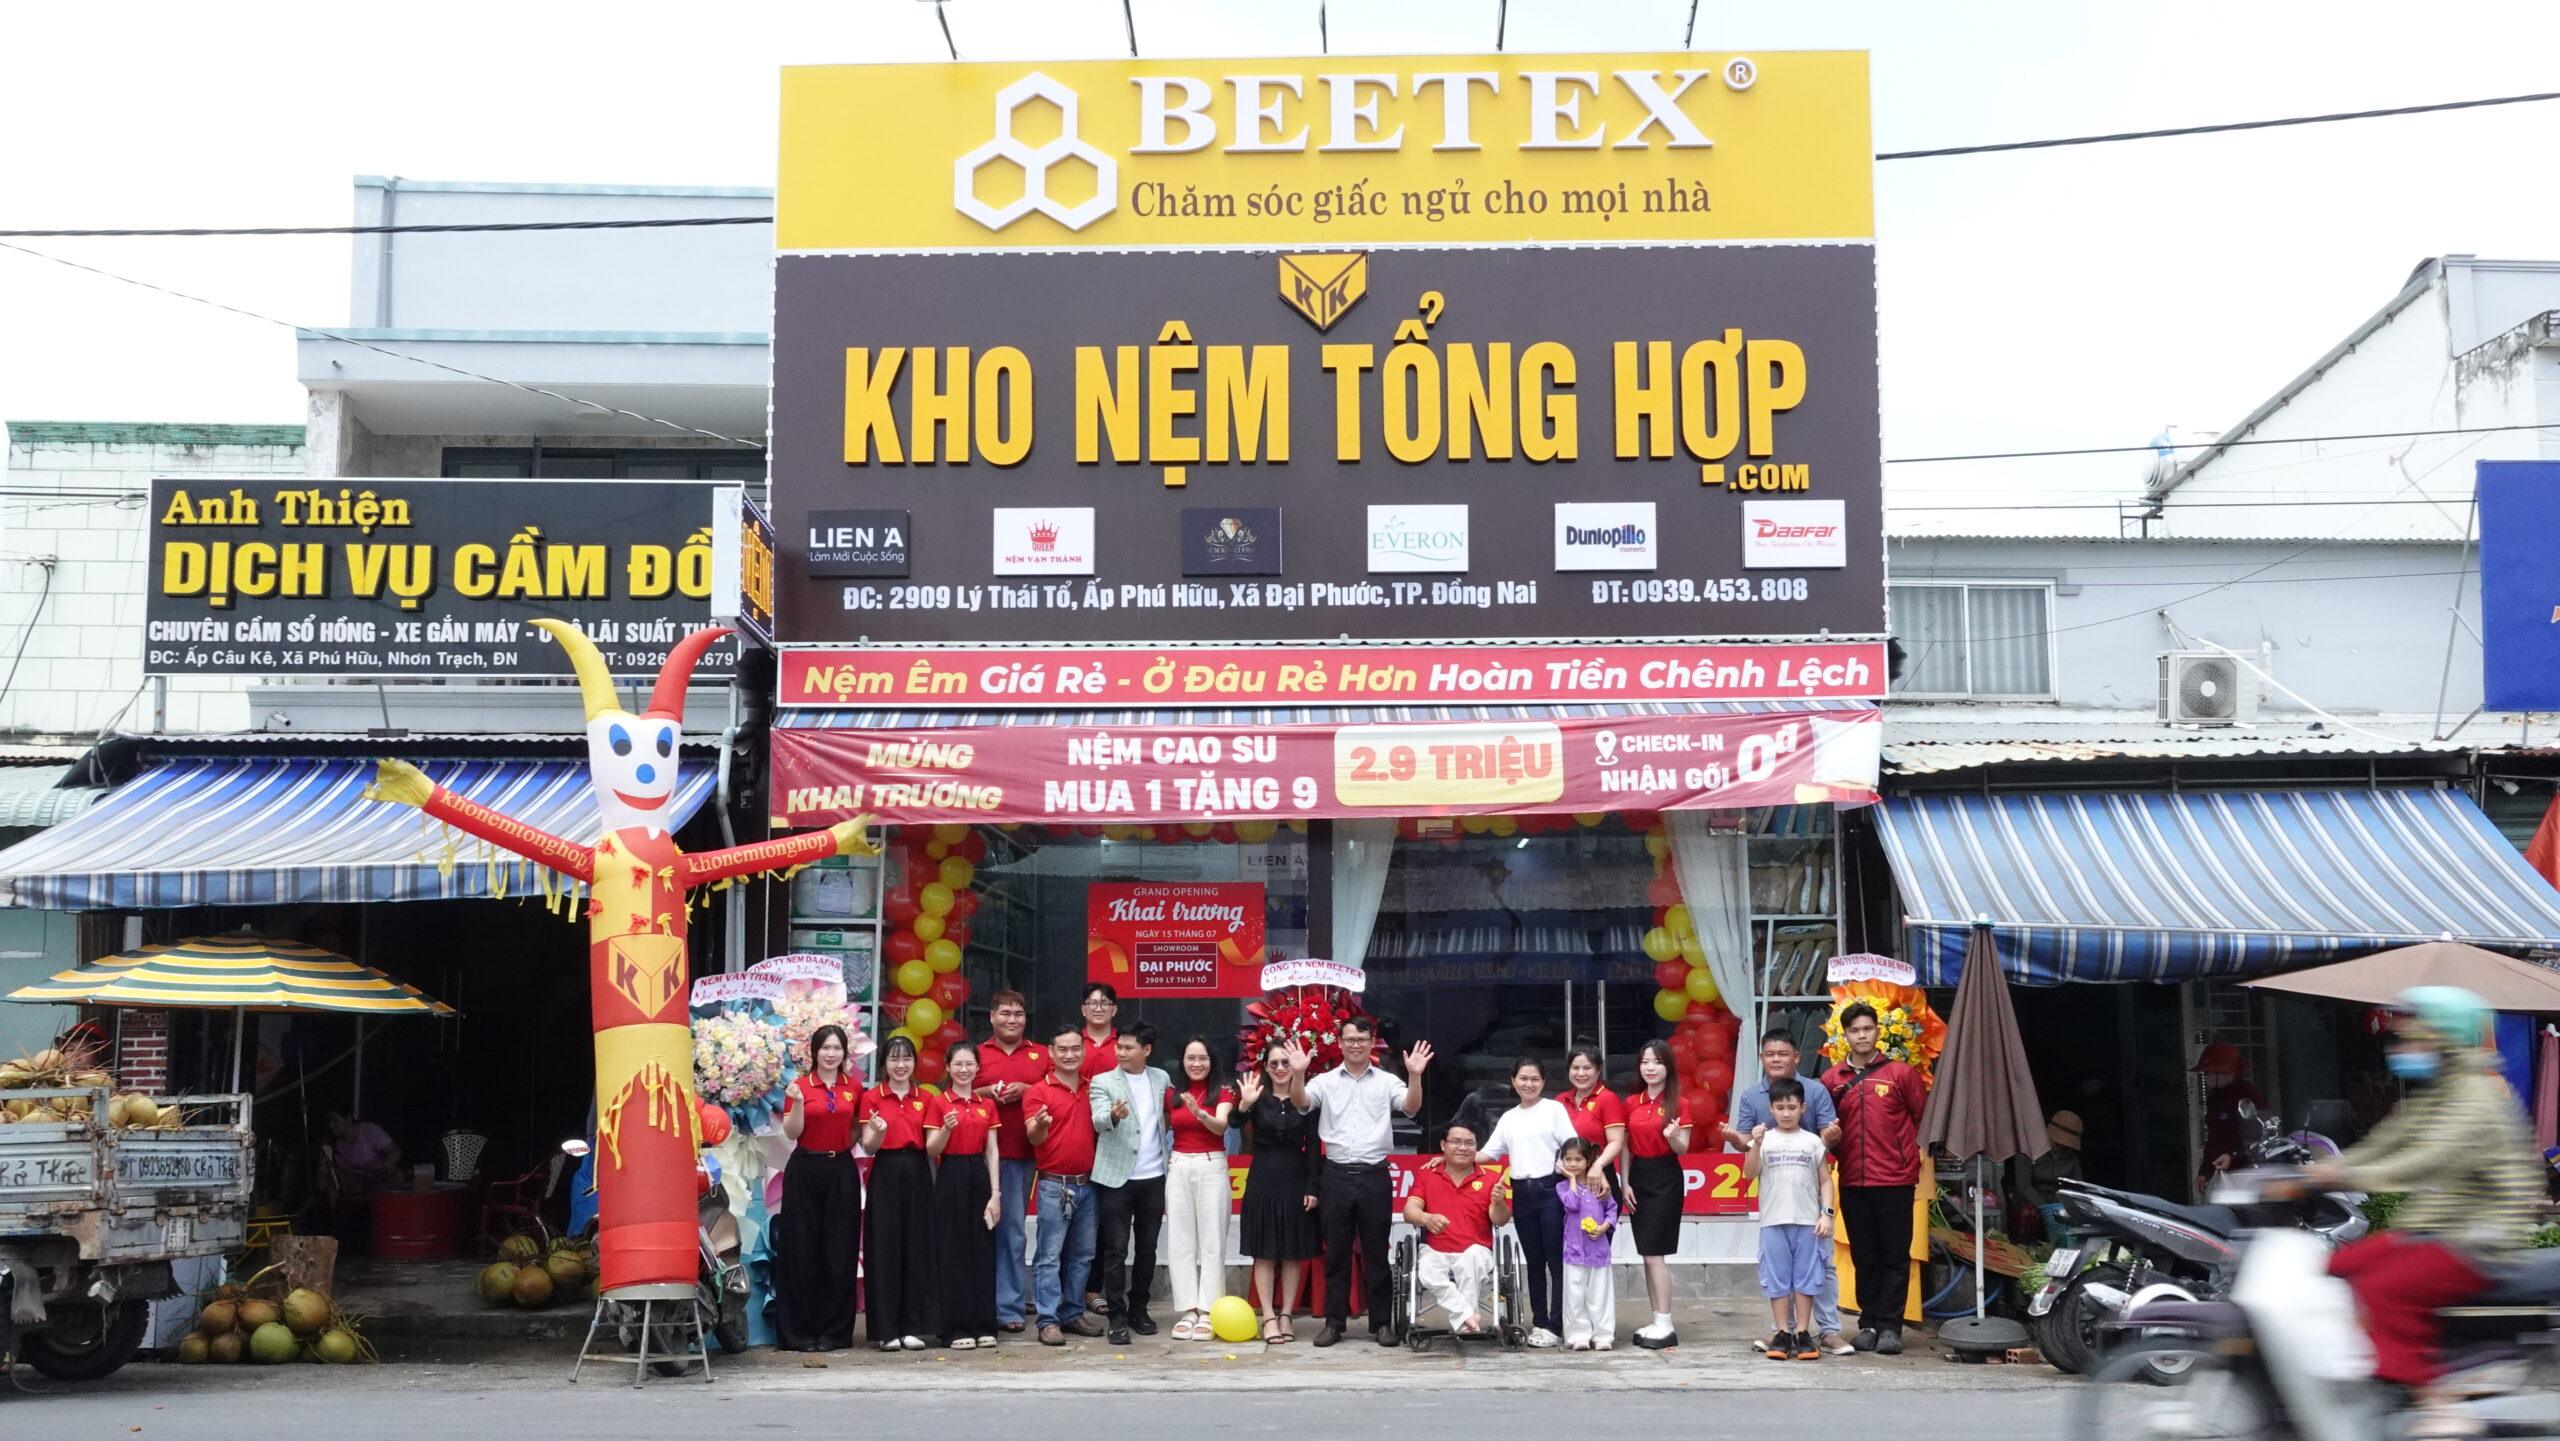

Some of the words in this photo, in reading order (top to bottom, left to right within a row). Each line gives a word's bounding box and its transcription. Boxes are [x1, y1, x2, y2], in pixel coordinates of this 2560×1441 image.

[1128, 69, 1715, 155] BEETEX
[1131, 181, 1237, 217] Chăm
[1247, 184, 1304, 217] sóc
[1313, 177, 1388, 223] giấc
[1402, 178, 1471, 222] ngủ
[1484, 180, 1548, 214] cho
[1562, 182, 1629, 222] mọi
[1643, 177, 1712, 213] nhà
[844, 346, 1033, 466] KHO
[1075, 320, 1289, 486] NỆM
[1321, 291, 1578, 463] TỔNG
[1614, 328, 1807, 483] HỢP
[1729, 464, 1810, 490] .COM
[161, 489, 259, 526] Anh
[275, 489, 412, 534] Thiện
[810, 528, 874, 548] LIEN
[1372, 531, 1464, 550] EVERON
[1566, 524, 1645, 547] Dunlopillo
[163, 541, 325, 606] DỊCH
[346, 544, 433, 609] VỤ
[453, 526, 606, 598] CẦM
[627, 527, 713, 598] ĐỒ
[852, 551, 878, 563] Cuộc
[880, 549, 904, 562] Sống
[843, 585, 882, 610] ĐC:
[889, 585, 951, 609] 2909
[957, 585, 983, 611] Lý
[988, 585, 1037, 608] Thái
[1043, 580, 1078, 610] Tổ,
[1083, 578, 1114, 610] Ấp
[1121, 583, 1165, 608] Phú
[1172, 583, 1224, 609] Hữu,
[1230, 582, 1260, 607] Xã
[1265, 583, 1304, 611] Đại
[1431, 578, 1491, 608] Đồng
[1497, 581, 1537, 604] Nai
[149, 617, 229, 643] CHUYÊN
[235, 615, 282, 643] CẦM
[287, 614, 315, 643] SỔ
[320, 616, 376, 643] HỒNG
[394, 622, 421, 643] XE
[427, 614, 469, 643] GẮN
[475, 617, 520, 643] MÁY
[588, 618, 619, 643] LÃI
[625, 616, 676, 643] SUẤT
[149, 650, 180, 665] ĐC:
[184, 646, 208, 667] Ấp
[212, 649, 245, 665] Câu
[250, 649, 277, 667] Kê,
[281, 650, 304, 665] Xã
[308, 649, 340, 665] Phú
[345, 649, 383, 668] Hữu,
[388, 649, 431, 665] Nhơn
[434, 650, 488, 668] Trạch,
[492, 652, 518, 666] ĐN
[804, 664, 893, 702] Nệm
[905, 659, 967, 694] Êm
[980, 662, 1043, 694] Giá
[1056, 662, 1106, 694] Rẻ
[1143, 657, 1176, 693] Ở
[1183, 662, 1265, 693] Đâu
[1278, 660, 1327, 692] Rẻ
[1339, 662, 1417, 691] Hơn
[1429, 660, 1532, 691] Hoàn
[1546, 655, 1627, 690] Tiền
[1639, 659, 1766, 688] Chênh
[1777, 658, 1870, 695] Lệch
[866, 737, 975, 770] MỪNG
[1067, 732, 1142, 770] NỆM
[1152, 738, 1221, 764] CAO
[1231, 736, 1278, 763] SU
[1622, 733, 1724, 754] CHECK-IN
[1350, 745, 1416, 782] 2.9
[1429, 736, 1553, 786] TRIỆU
[1044, 779, 1136, 812] MUA
[1146, 779, 1161, 810] 1
[1173, 772, 1279, 817] TẶNG
[1293, 776, 1318, 809] 9
[1600, 767, 1678, 796] NHẬN
[1684, 763, 1729, 792] GỐI
[787, 785, 863, 813] KHAI
[870, 781, 1004, 810] TRƯƠNG
[440, 793, 588, 868] khonemtonghop
[688, 833, 828, 874] khonemtonghop
[1248, 856, 1287, 866] LIEN
[1133, 888, 1169, 896] GRAND
[1173, 887, 1218, 896] OPENING
[1109, 898, 1166, 922] Khai
[1172, 900, 1245, 933] trương
[1136, 929, 1159, 938] NGÀY
[1174, 928, 1204, 938] THÁNG
[1206, 930, 1216, 938] 07
[806, 955, 841, 970] DAAFAR
[1139, 961, 1163, 975] ĐẠI
[1166, 959, 1213, 972] PHƯỚC
[1327, 961, 1363, 978] BEETEX
[1166, 975, 1174, 983] LÝ
[1177, 975, 1194, 983] THÁI
